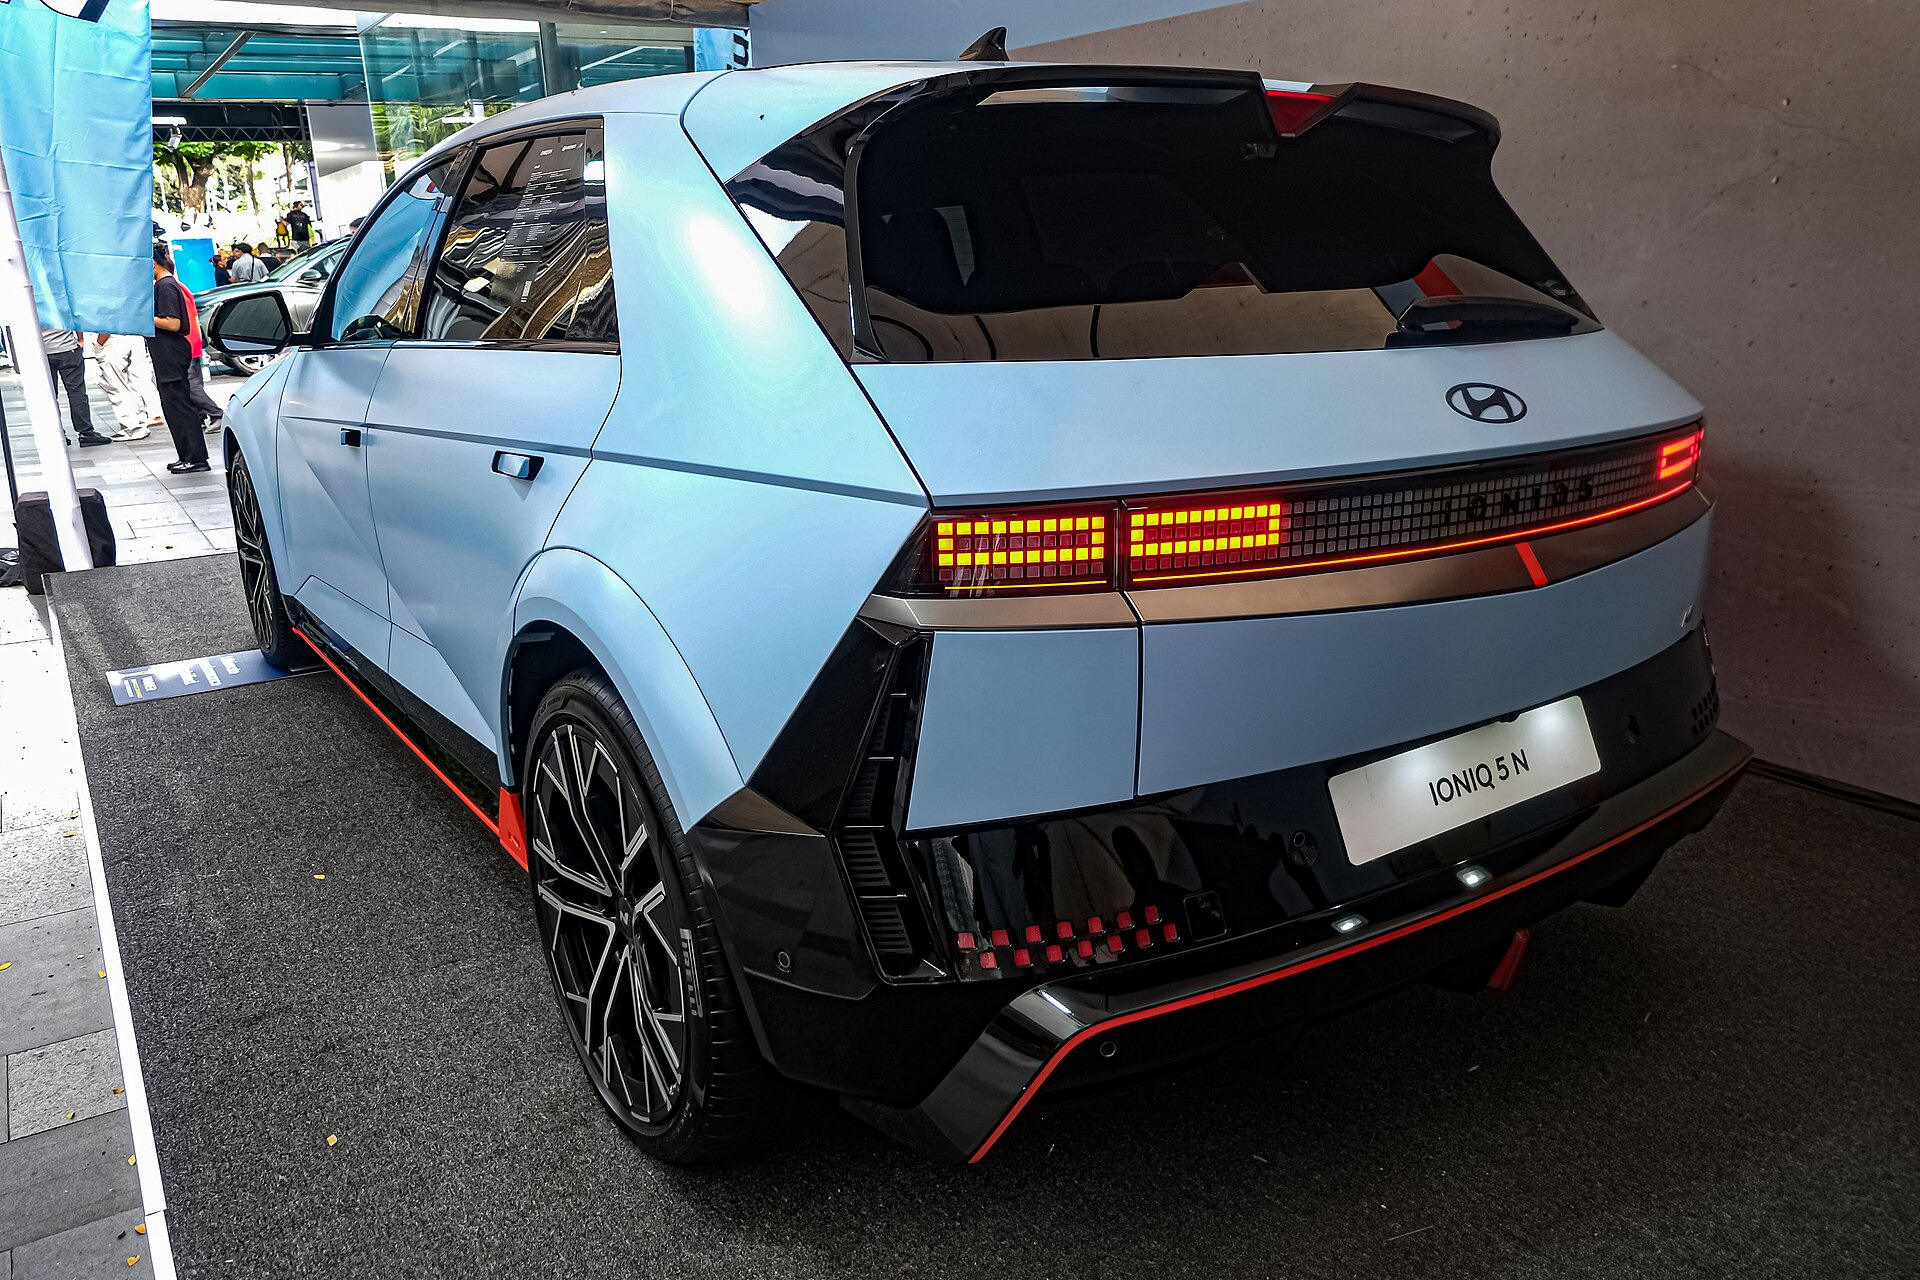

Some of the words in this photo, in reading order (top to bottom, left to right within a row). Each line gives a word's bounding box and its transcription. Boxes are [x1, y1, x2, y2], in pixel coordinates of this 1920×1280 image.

[1429, 763, 1495, 806] IONIQ
[1495, 756, 1509, 780] 5
[1511, 749, 1529, 775] N
